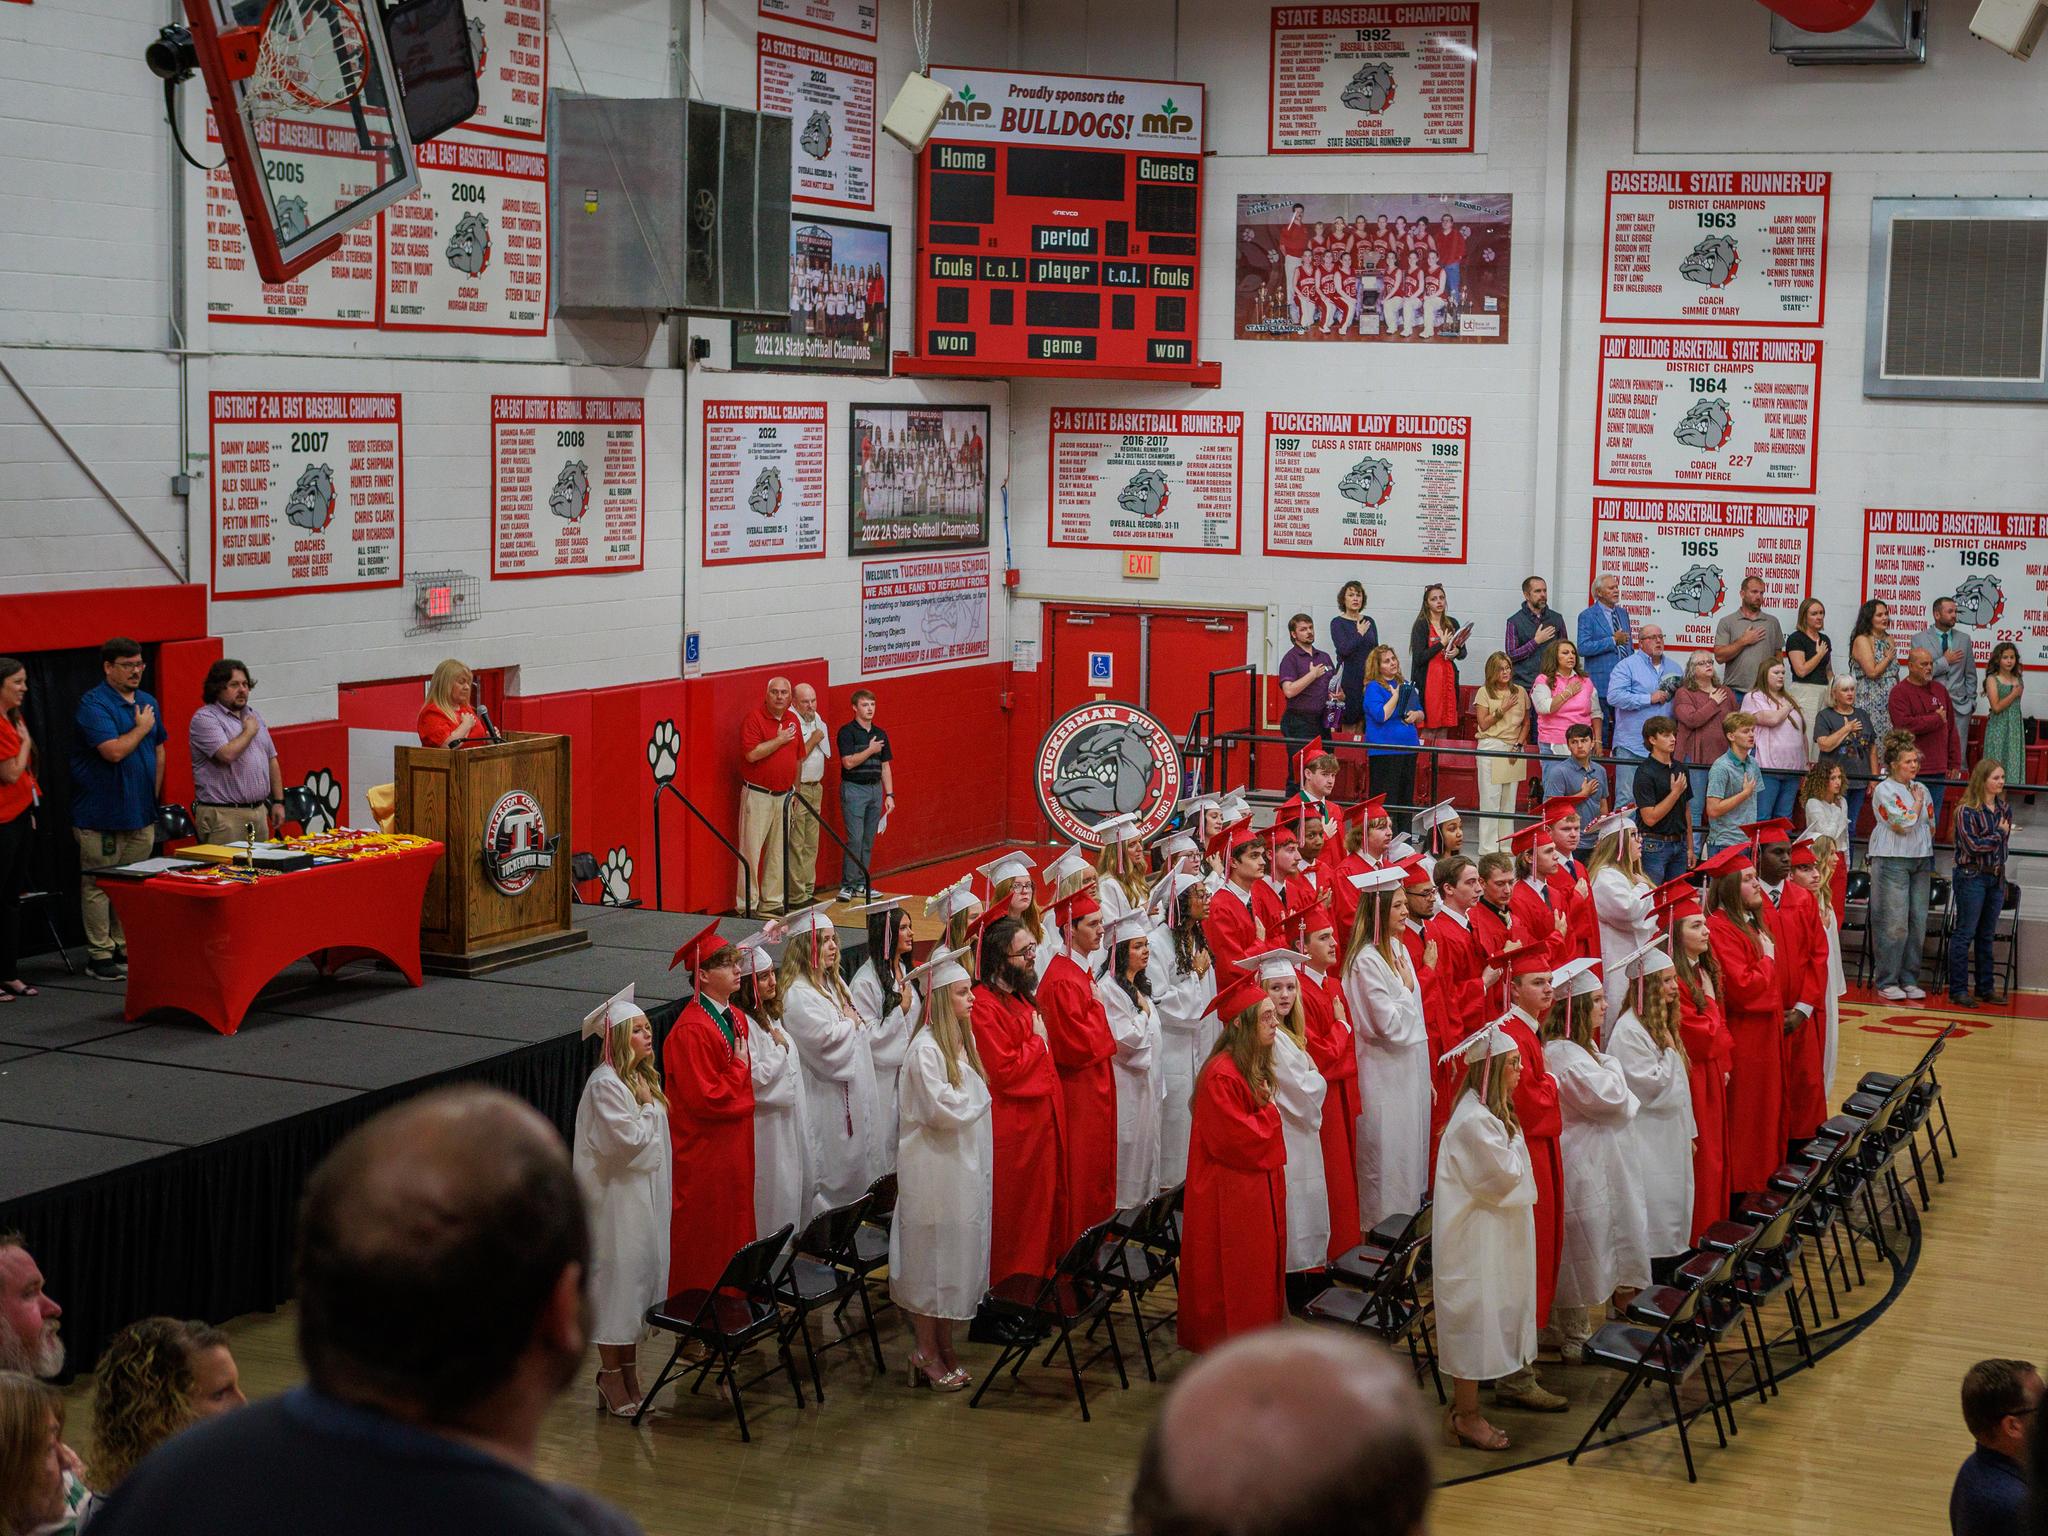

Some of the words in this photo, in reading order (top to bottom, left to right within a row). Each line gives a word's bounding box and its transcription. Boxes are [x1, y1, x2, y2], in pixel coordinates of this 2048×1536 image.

[1277, 9, 1317, 25] STATE
[1323, 8, 1392, 24] BASEBALL
[1396, 6, 1471, 23] CHAMPION
[1356, 29, 1390, 41] 1992
[811, 70, 827, 83] 2021
[1008, 84, 1053, 103] Proudly
[1056, 88, 1104, 104] sponsors
[1107, 90, 1124, 104] the
[1000, 107, 1134, 140] BULLDOGS!
[1358, 120, 1382, 128] COACH
[279, 124, 324, 150] BASEBALL
[1328, 138, 1343, 146] STATE
[1345, 138, 1378, 146] BASKETBALL
[1380, 137, 1411, 146] RUNNER-UP
[420, 144, 436, 163] 2-AA
[440, 145, 456, 165] EAST
[460, 148, 503, 171] BASKETBALL
[506, 154, 544, 176] CHAMPIONS
[941, 148, 986, 169] Home
[267, 161, 304, 183] 2005
[1140, 159, 1194, 182] Guests
[1612, 174, 1683, 192] BASEBALL
[1690, 174, 1733, 192] STATE
[1742, 174, 1826, 192] RUNNER-UP
[452, 183, 485, 203] 2004
[1669, 200, 1708, 209] DISTRICT
[1713, 200, 1766, 210] CHAMPIONS
[1697, 213, 1736, 228] 1963
[1795, 216, 1816, 224] MOODY
[1041, 228, 1089, 250] period
[1616, 234, 1629, 242] BILLY
[1632, 234, 1652, 242] GEORGE
[391, 243, 405, 256] ZACK
[407, 244, 429, 257] SKAGGS
[935, 258, 972, 277] fouls
[1039, 262, 1089, 282] player
[1108, 268, 1140, 284] t.o.l.
[1154, 268, 1189, 286] fouls
[1699, 297, 1724, 305] COACH
[1683, 307, 1709, 315] SIMMIE
[1712, 307, 1740, 316] O'MARY
[756, 336, 773, 355] 2021
[775, 337, 784, 355] 2A
[786, 338, 804, 356] State
[806, 339, 833, 357] Softball
[834, 340, 870, 363] Champions
[937, 336, 968, 350] won
[1043, 338, 1082, 357] game
[1155, 343, 1184, 358] won
[1605, 340, 1625, 358] LADY
[1630, 340, 1669, 358] BULLDOG
[1673, 341, 1728, 360] BASKETBALL
[1732, 343, 1759, 360] STATE
[1762, 343, 1815, 362] RUNNER-UP
[1667, 363, 1710, 372] DISTRICT
[1714, 364, 1753, 373] CHAMPS
[1689, 377, 1727, 393] 1964
[215, 396, 257, 418] DISTRICT
[260, 397, 280, 418] 2-AA
[283, 397, 302, 418] EAST
[306, 398, 347, 418] BASEBALL
[350, 398, 395, 418] CHAMPIONS
[1609, 394, 1632, 404] LUCENIA
[1633, 395, 1658, 405] BRADLEY
[525, 400, 549, 418] DISTRICT
[557, 401, 582, 419] REGIONAL
[586, 401, 611, 419] SOFTBALL
[613, 402, 641, 419] CHAMPIONS
[707, 406, 718, 418] 2A
[720, 406, 744, 419] STATE
[745, 406, 781, 419] SOFTBALL
[783, 407, 824, 419] CHAMPIONS
[1054, 413, 1071, 430] 3-A
[1074, 413, 1107, 430] STATE
[1110, 413, 1177, 432] BASKETBALL
[1182, 415, 1241, 434] RUNNER-UP
[1272, 414, 1352, 432] TUCKERMAN
[1358, 416, 1392, 433] LADY
[1396, 417, 1466, 435] BULLDOGS
[557, 431, 584, 447] 2008
[759, 428, 776, 438] 2022
[1123, 436, 1168, 446] 2016-2017
[221, 441, 244, 455] DANNY
[247, 441, 269, 454] ADAMS
[291, 432, 329, 452] 2007
[1275, 439, 1300, 450] 1997
[1312, 440, 1337, 450] CLASS
[1340, 441, 1345, 450] A
[1349, 441, 1372, 450] STATE
[1375, 442, 1422, 452] CHAMPIONS
[1432, 444, 1458, 456] 1998
[1729, 455, 1753, 467] 22-7
[1675, 471, 1703, 480] TOMMY
[1705, 471, 1731, 480] PIERCE
[1599, 501, 1620, 519] LADY
[1624, 502, 1663, 520] BULLDOG
[1667, 503, 1722, 522] BASKETBALL
[1726, 505, 1753, 524] STATE
[1756, 506, 1808, 526] RUNNER-UP
[862, 524, 880, 541] 2022
[882, 527, 891, 539] 2A
[892, 525, 911, 540] State
[913, 522, 940, 538] Softball
[941, 521, 979, 538] Champions
[1870, 512, 1893, 531] LADY
[1896, 513, 1939, 532] BULLDOG
[1943, 514, 2001, 534] BASKETBALL
[2007, 516, 2035, 535] STATE
[295, 540, 325, 552] COACHES
[1344, 538, 1364, 546] ALVIN
[1366, 538, 1385, 547] RILEY
[1681, 542, 1718, 556] 1965
[1758, 538, 1778, 549] DOTTIE
[1780, 539, 1801, 550] BUTLER
[1129, 554, 1152, 574] EXIT
[1960, 551, 1999, 567] 1966
[866, 570, 891, 581] WELCOME
[893, 569, 898, 578] TO
[900, 563, 942, 577] TUCKERMAN
[944, 561, 960, 572] HIGH
[962, 558, 987, 571] SCHOOL
[866, 588, 876, 597] WE
[878, 586, 892, 596] ASK
[895, 585, 907, 594] ALL
[909, 584, 925, 593] FANS
[928, 582, 936, 591] TO
[938, 578, 965, 590] REFRAIN
[1874, 574, 1897, 585] MARCIA
[1899, 575, 1919, 586] JOHNS
[882, 615, 901, 623] profanity
[869, 630, 888, 638] Throwing
[889, 628, 905, 636] Objects
[1997, 630, 2023, 641] 22-2
[1043, 709, 1116, 781] TUCKERMAN
[1048, 797, 1067, 821] PRIDE
[1155, 801, 1171, 820] 1903
[504, 813, 536, 854] T
[502, 854, 536, 876] TUCKERMAN
